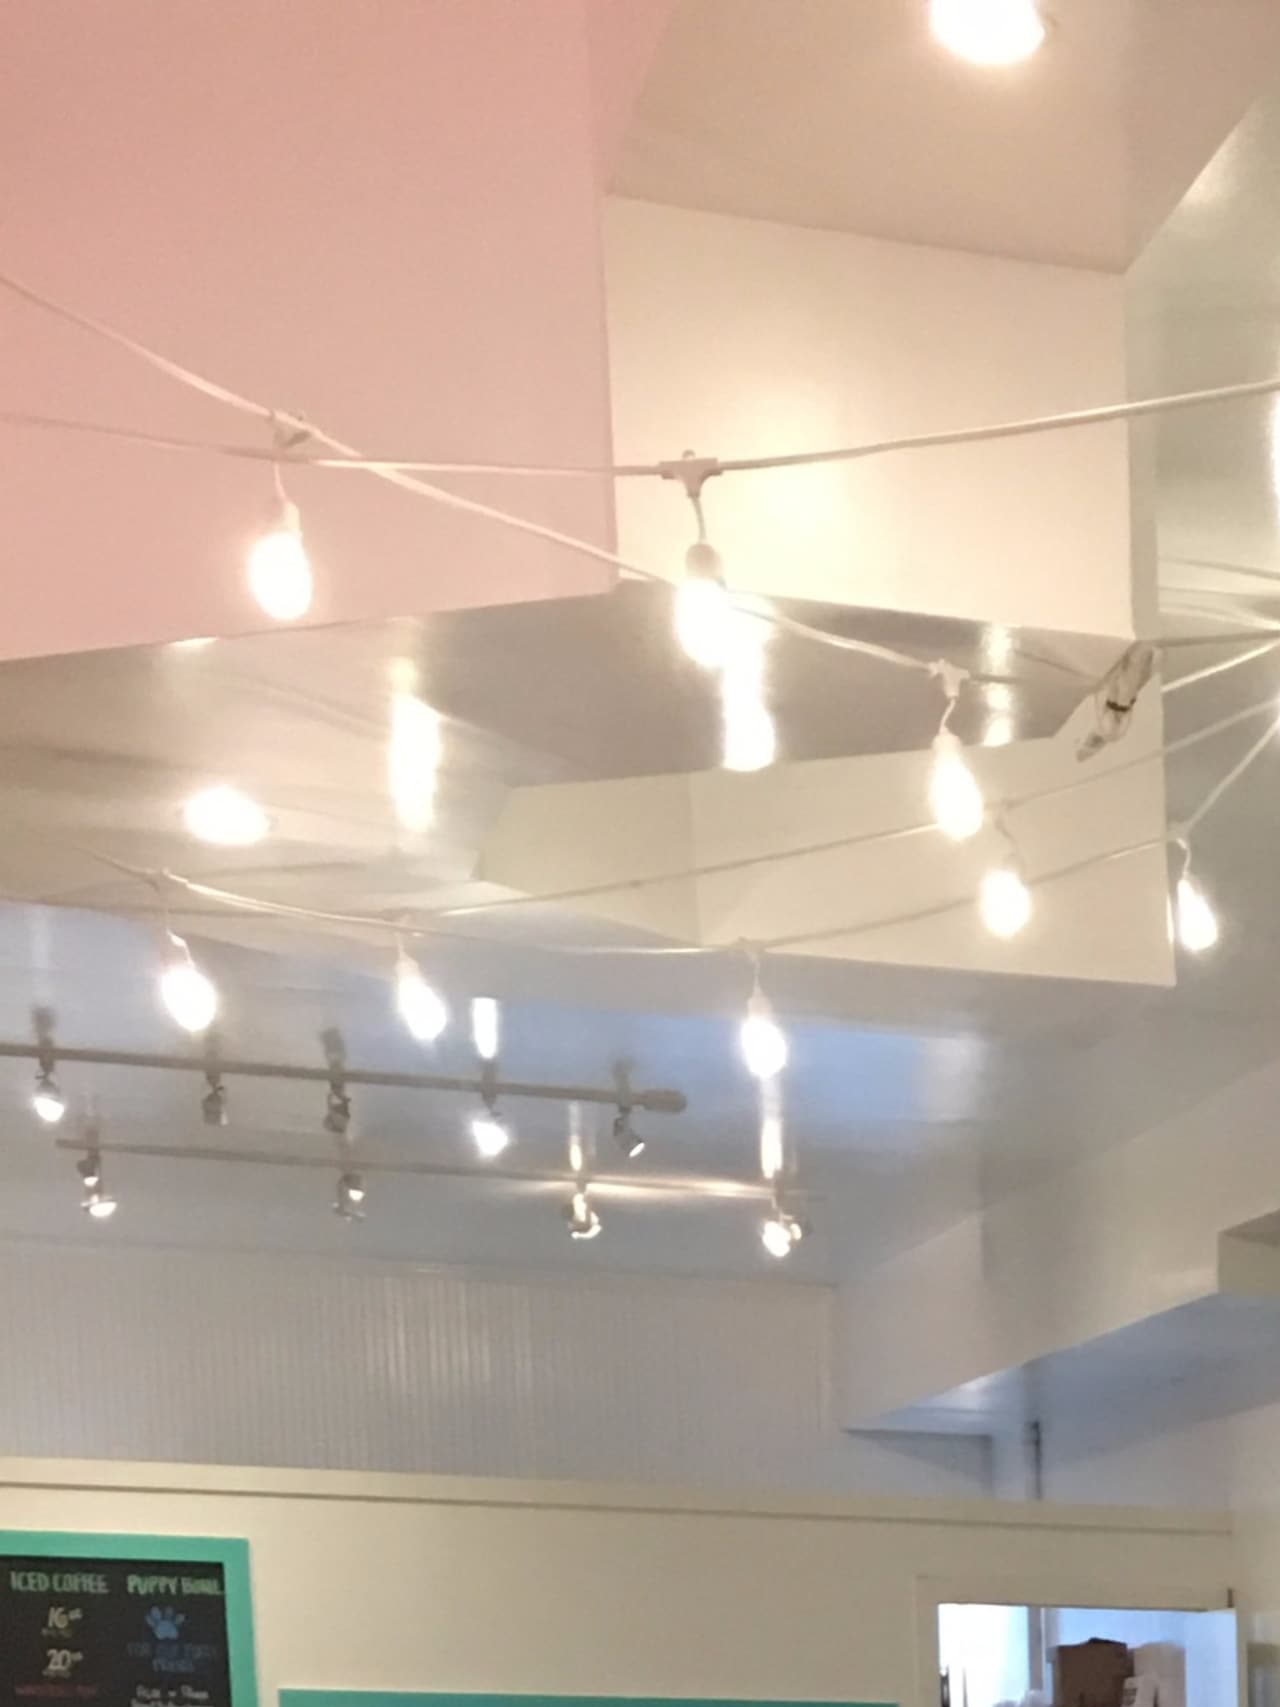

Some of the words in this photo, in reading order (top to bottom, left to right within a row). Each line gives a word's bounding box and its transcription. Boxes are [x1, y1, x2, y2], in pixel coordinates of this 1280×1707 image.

[9, 1571, 49, 1592] ICED
[52, 1572, 110, 1594] COFFEE
[126, 1573, 177, 1595] PUPPY
